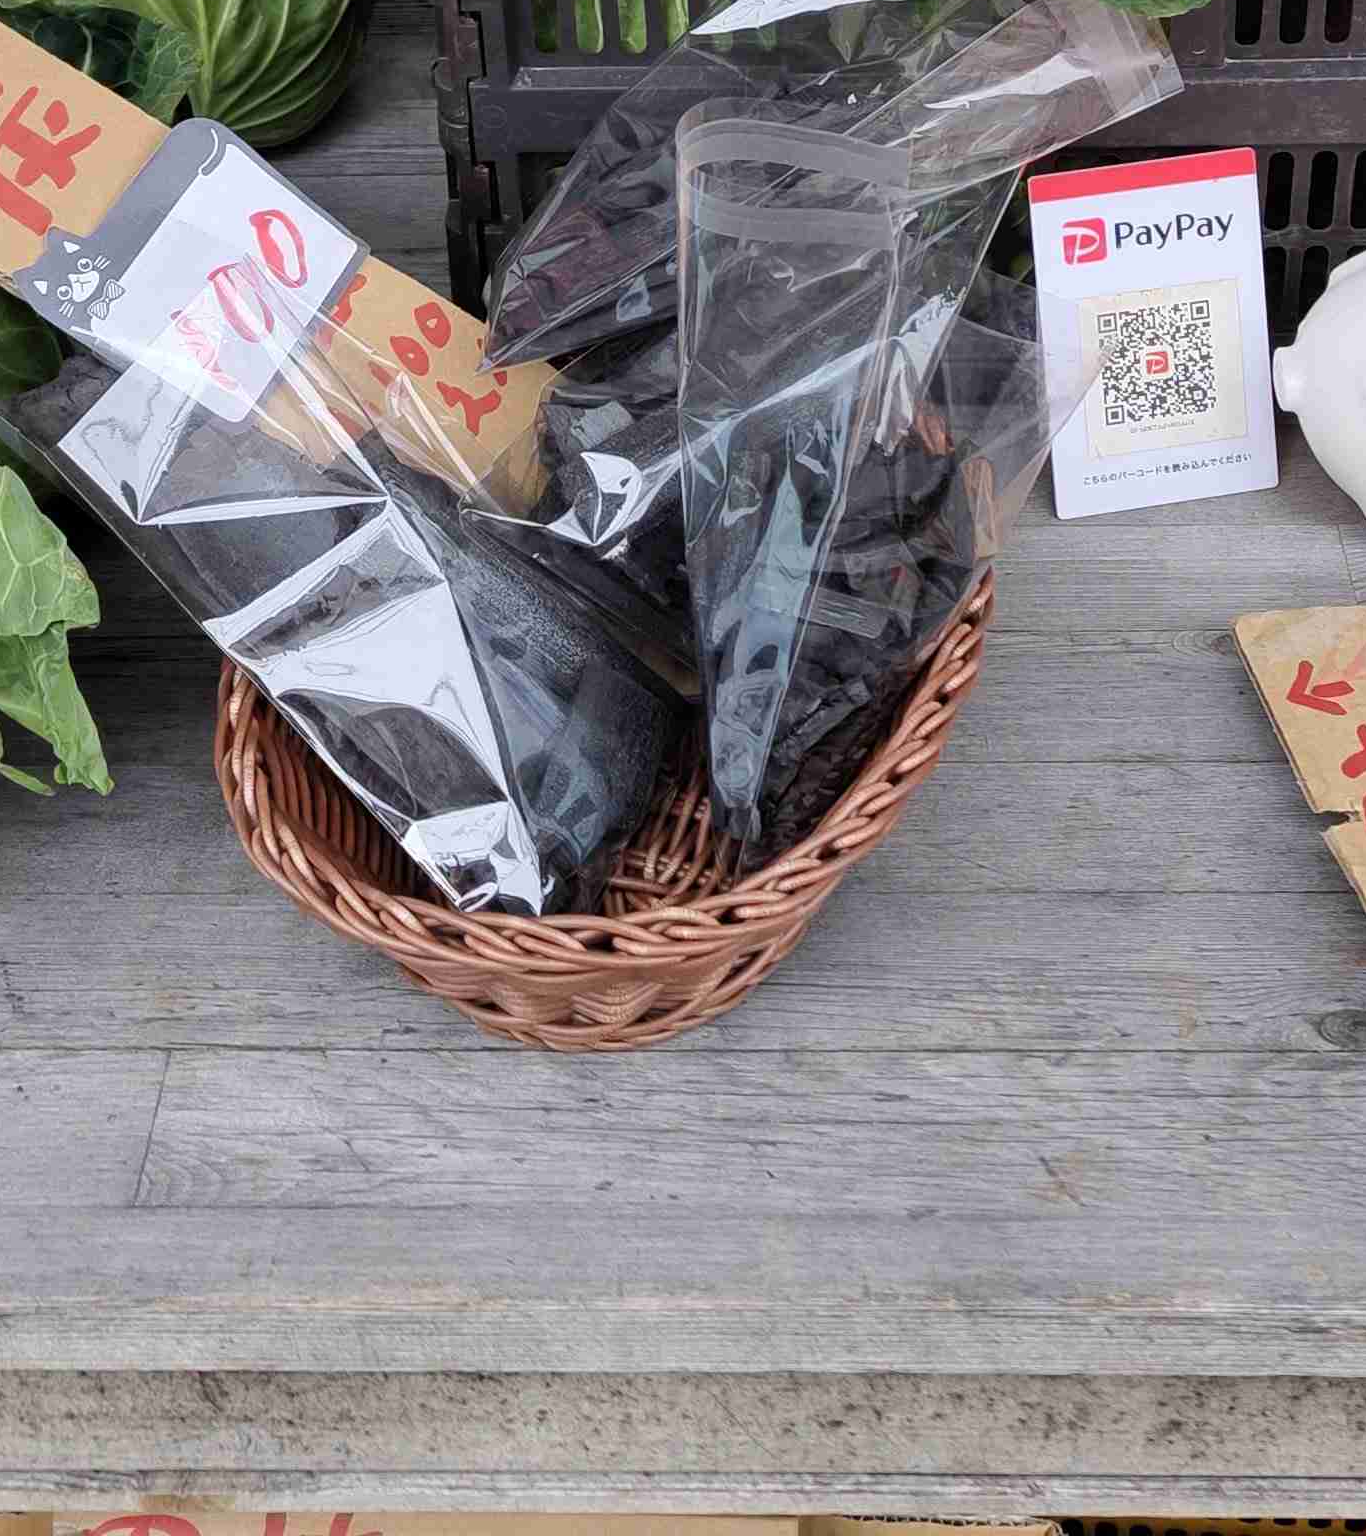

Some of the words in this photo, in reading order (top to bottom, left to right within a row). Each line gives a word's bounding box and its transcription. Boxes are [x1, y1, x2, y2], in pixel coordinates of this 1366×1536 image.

[1115, 214, 1234, 250] PayPay
[1083, 452, 1253, 486] こちらのバーコードを読み込んでください
